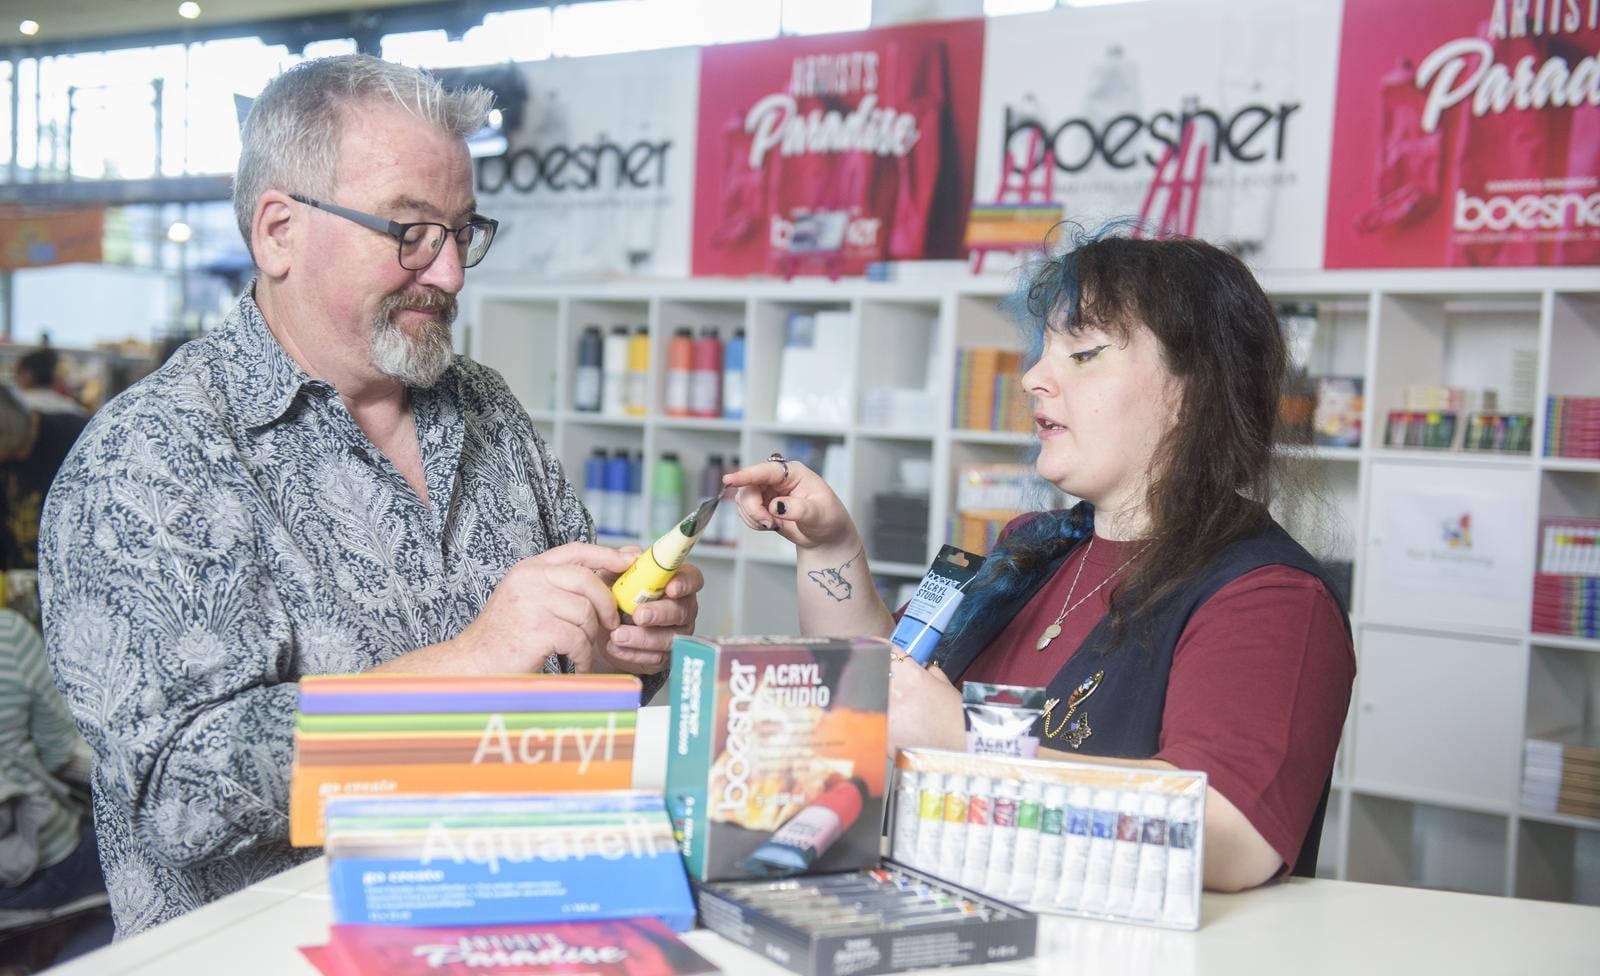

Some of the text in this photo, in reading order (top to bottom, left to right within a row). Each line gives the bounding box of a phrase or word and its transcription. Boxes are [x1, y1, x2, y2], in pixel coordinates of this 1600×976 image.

[743, 92, 921, 169] Paradise
[1003, 102, 1302, 174] boesner
[916, 588, 943, 604] STUDIO
[921, 580, 949, 597] ACRYL
[762, 685, 831, 708] STUDIO
[763, 663, 822, 686] ACRYL
[472, 712, 616, 775] Acryl
[719, 658, 758, 812] boesner
[420, 811, 658, 875] Aquarell
